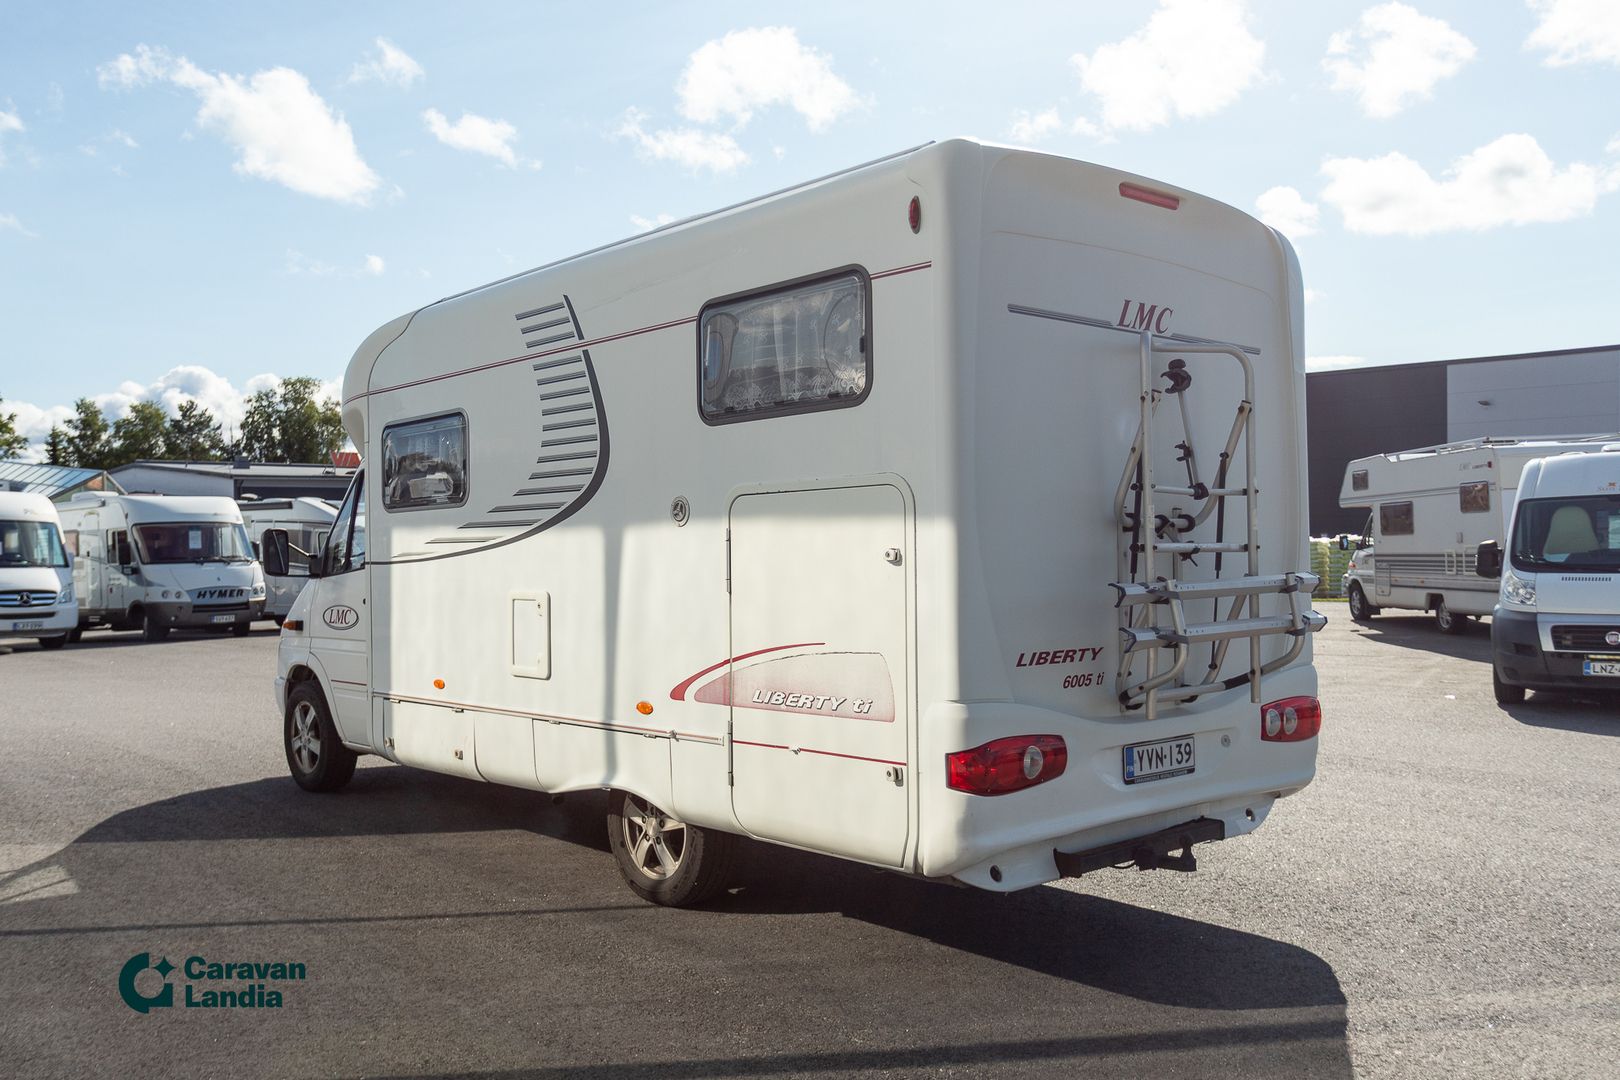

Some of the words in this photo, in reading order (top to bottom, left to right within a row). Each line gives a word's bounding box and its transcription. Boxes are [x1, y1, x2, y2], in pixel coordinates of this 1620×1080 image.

[1117, 299, 1174, 334] LMC
[197, 589, 245, 599] HYMER
[329, 608, 352, 625] LMC
[1016, 646, 1104, 668] LIBERTY
[1063, 673, 1093, 689] 6005
[1096, 671, 1105, 686] ti
[752, 689, 847, 711] LIBERTY
[853, 699, 873, 713] ti
[1137, 742, 1193, 772] YVN-139
